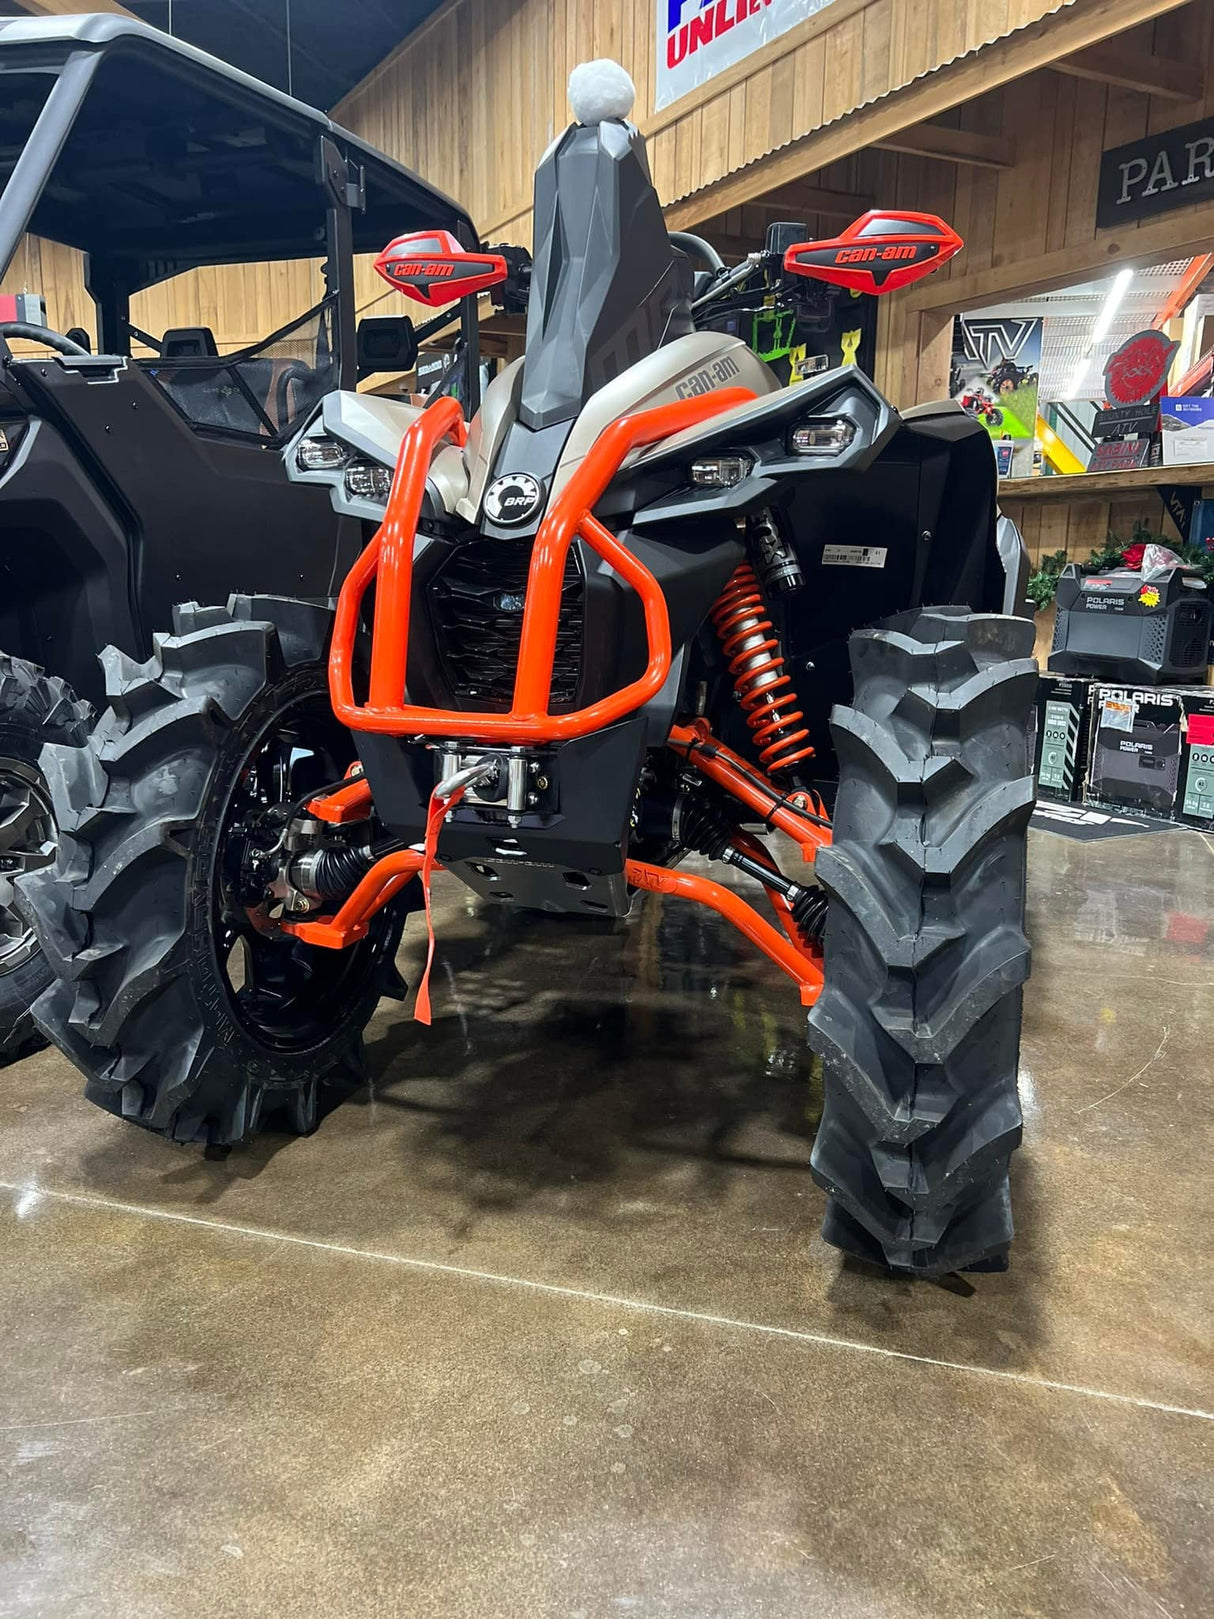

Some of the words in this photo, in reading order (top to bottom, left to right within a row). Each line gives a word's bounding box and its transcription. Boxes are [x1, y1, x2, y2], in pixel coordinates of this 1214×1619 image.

[1116, 137, 1214, 205] PAR
[834, 245, 918, 264] can-am
[393, 263, 455, 277] can-am
[674, 355, 741, 401] can-am
[1111, 421, 1138, 436] ATV
[504, 496, 536, 507] BRP
[1086, 597, 1125, 606] POLARIS
[1099, 688, 1174, 707] POLARIS
[1120, 740, 1153, 751] POLARIS
